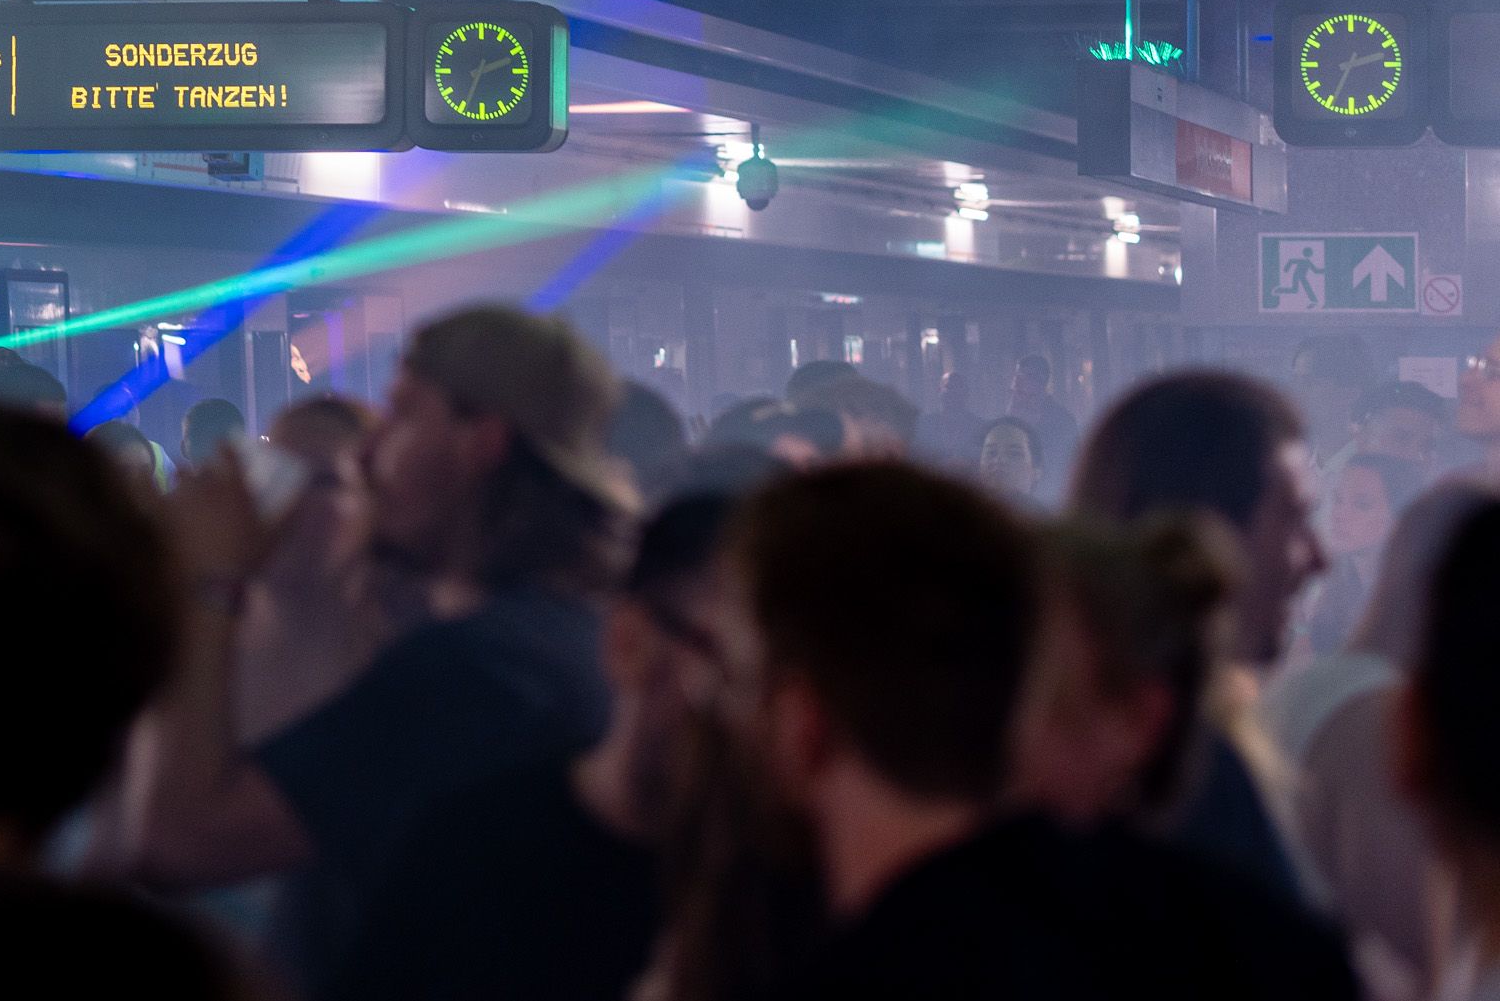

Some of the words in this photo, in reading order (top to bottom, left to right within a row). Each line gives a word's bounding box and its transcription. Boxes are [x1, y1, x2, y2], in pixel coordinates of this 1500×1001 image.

[104, 42, 259, 68] SONDERZUG
[70, 85, 156, 110] BITTE
[174, 84, 289, 110] TANZEN!
